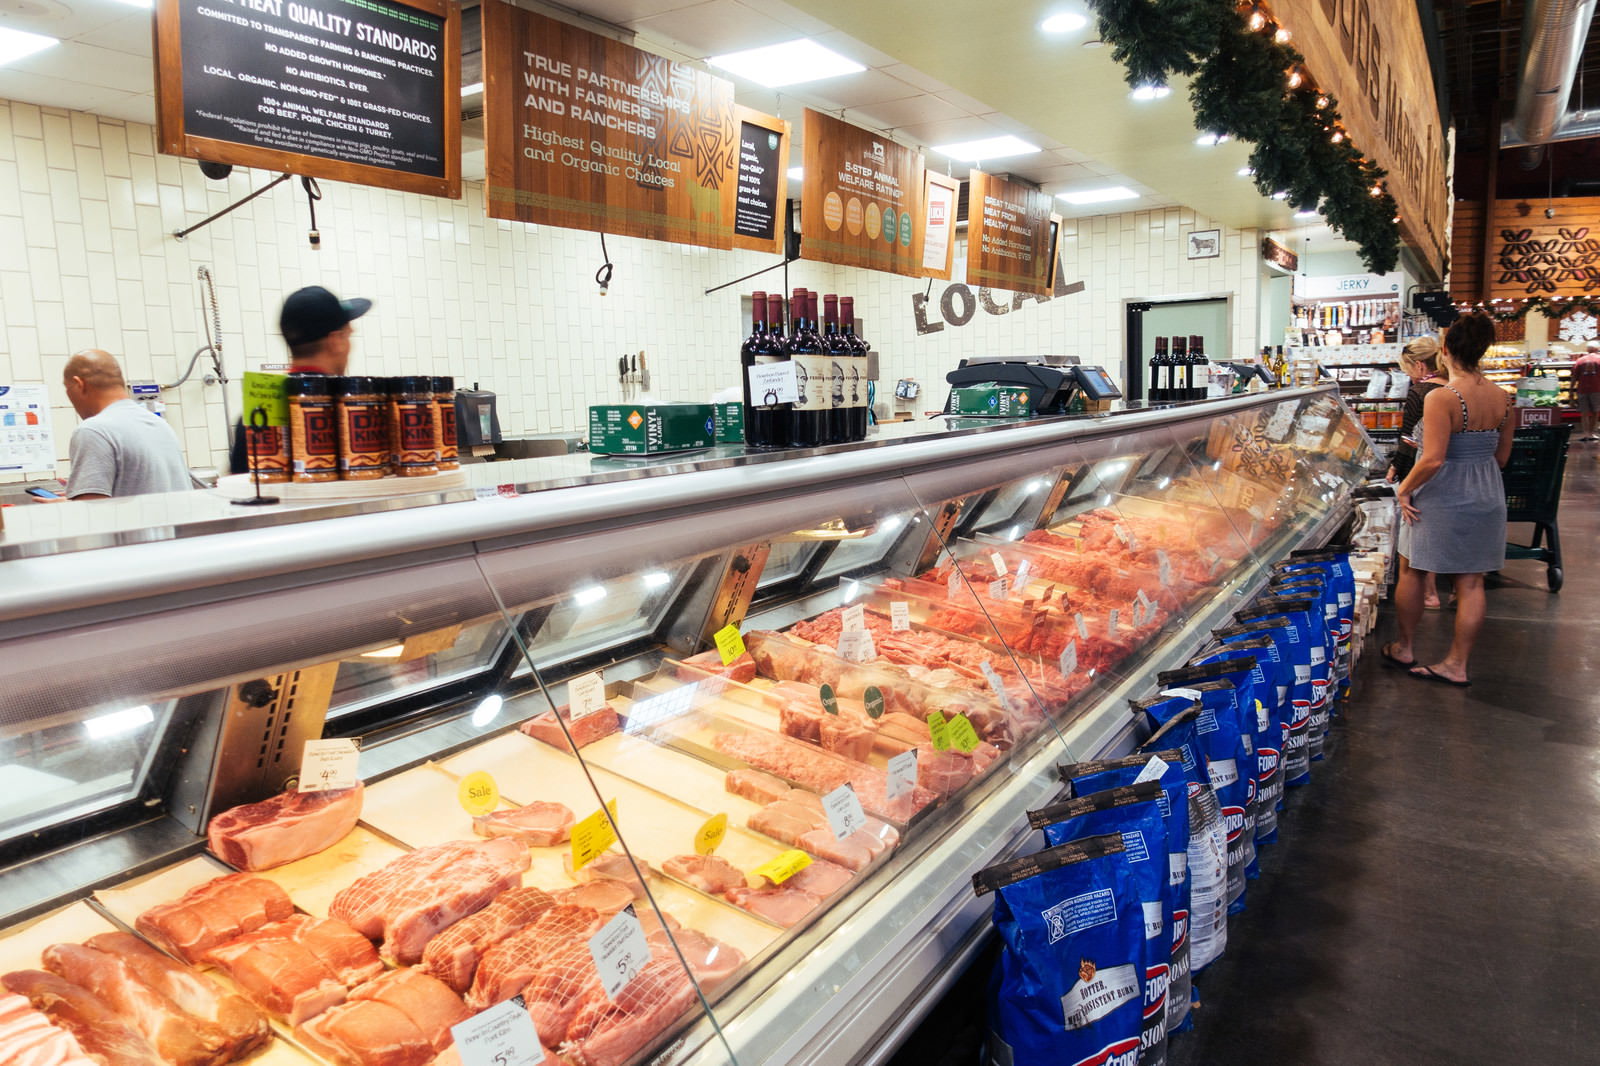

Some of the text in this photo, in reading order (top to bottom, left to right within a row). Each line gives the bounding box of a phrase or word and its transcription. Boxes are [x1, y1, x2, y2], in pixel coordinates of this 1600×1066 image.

[197, 6, 249, 27] COMMITTED
[250, 20, 262, 31] TO
[263, 24, 319, 46] TRANSPARENT
[320, 40, 353, 55] FARMING
[361, 51, 397, 67] RANCHING
[398, 61, 435, 77] PRACTICES.
[288, 2, 352, 37] QUALITY
[356, 22, 437, 61] STANDARDS
[265, 42, 278, 53] NO
[279, 47, 307, 61] ADDED
[308, 54, 341, 69] GROWTH
[286, 66, 298, 76] NO
[523, 51, 691, 115] TRUE PARTNERSHIPS
[524, 72, 652, 120] WITH FARMERS
[257, 105, 275, 115] FOR
[325, 119, 358, 132] CHICKEN
[282, 102, 311, 114] ANIMAL
[312, 107, 347, 122] WELFARE
[347, 115, 390, 130] STANDARDS
[362, 102, 402, 117] GRASS-FED
[524, 94, 657, 140] AND RANCHERS
[523, 124, 681, 173] Highest Quality, Local
[524, 147, 675, 188] and Organic Choices
[873, 170, 900, 188] ANIMAL
[838, 171, 875, 191] WELFARE
[984, 195, 1004, 209] GREAT
[984, 206, 1017, 223] MEAT FROM
[984, 217, 1032, 238] HEALTHY ANIMALS
[1337, 279, 1371, 291] JERKY
[648, 409, 657, 445] VINYL
[1524, 413, 1548, 421] LOCAL
[1259, 758, 1277, 778] FORD
[468, 785, 491, 799] Sale
